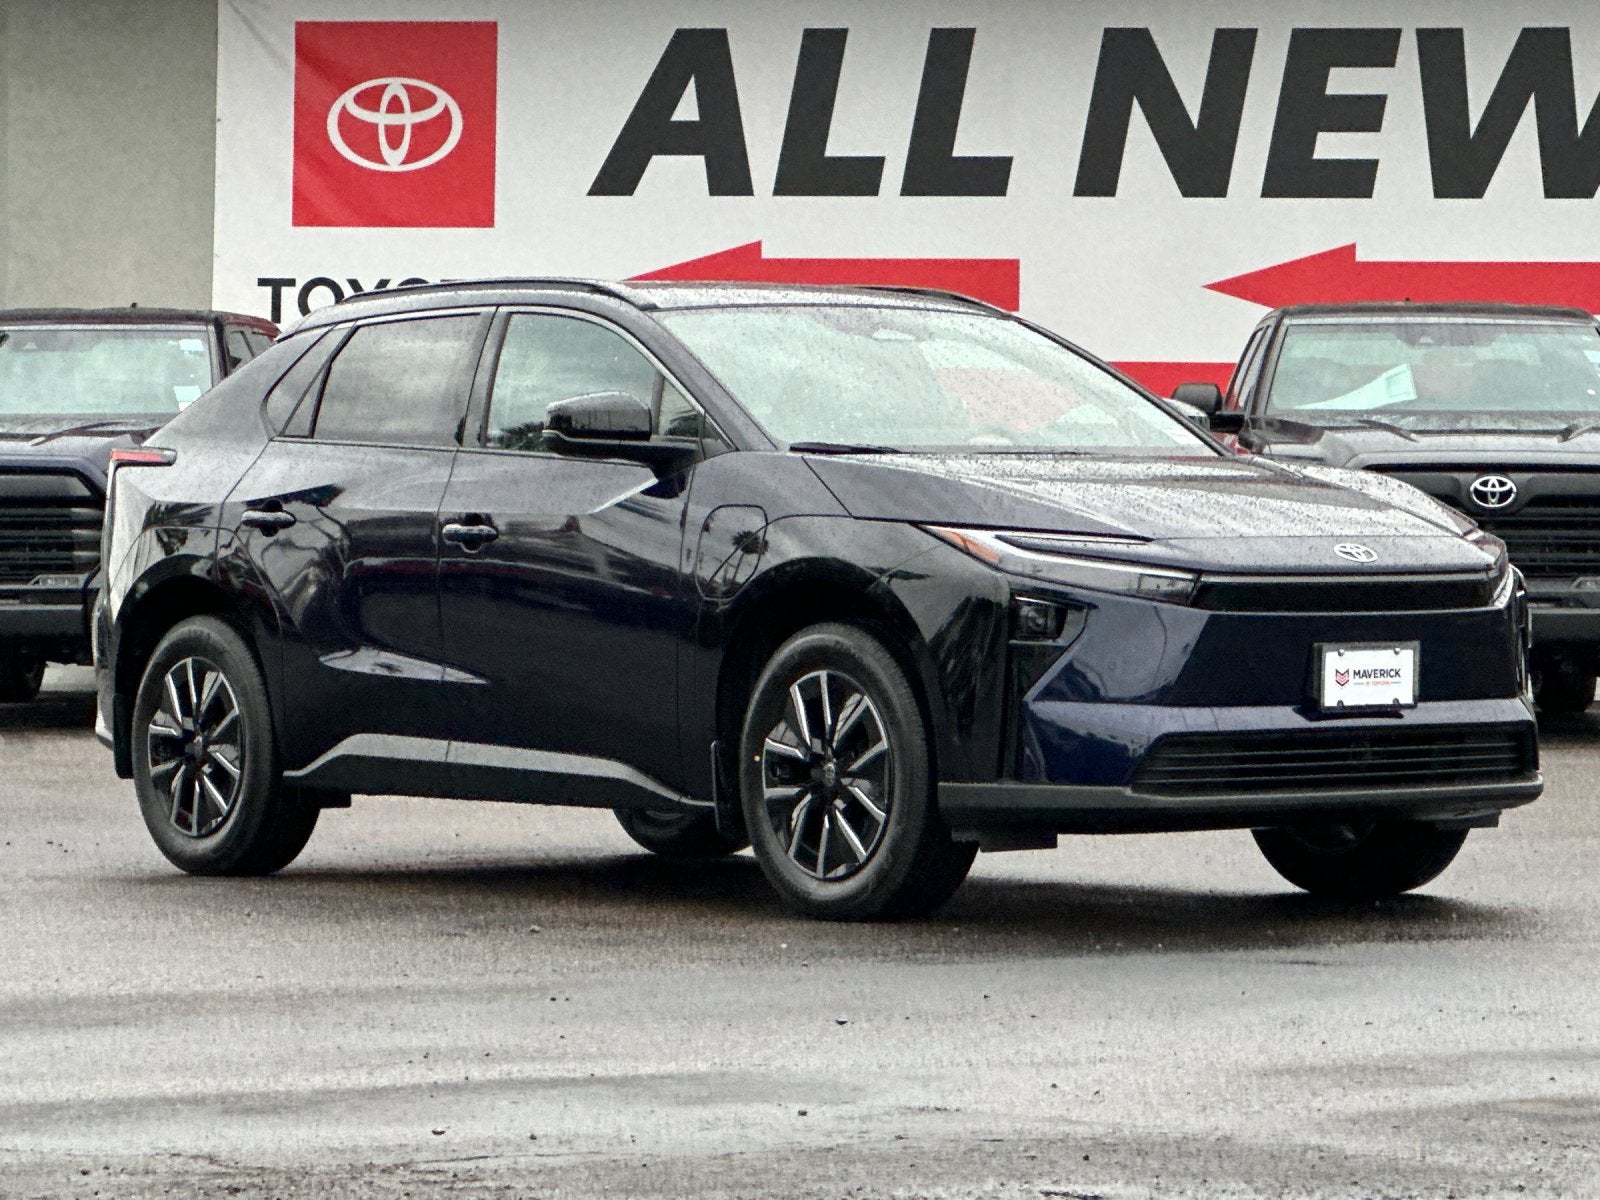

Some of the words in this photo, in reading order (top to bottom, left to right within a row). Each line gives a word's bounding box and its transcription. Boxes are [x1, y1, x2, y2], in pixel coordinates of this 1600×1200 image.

[587, 27, 1013, 197] ALL
[1073, 27, 1600, 199] NEW
[1353, 668, 1401, 679] MAVERICK
